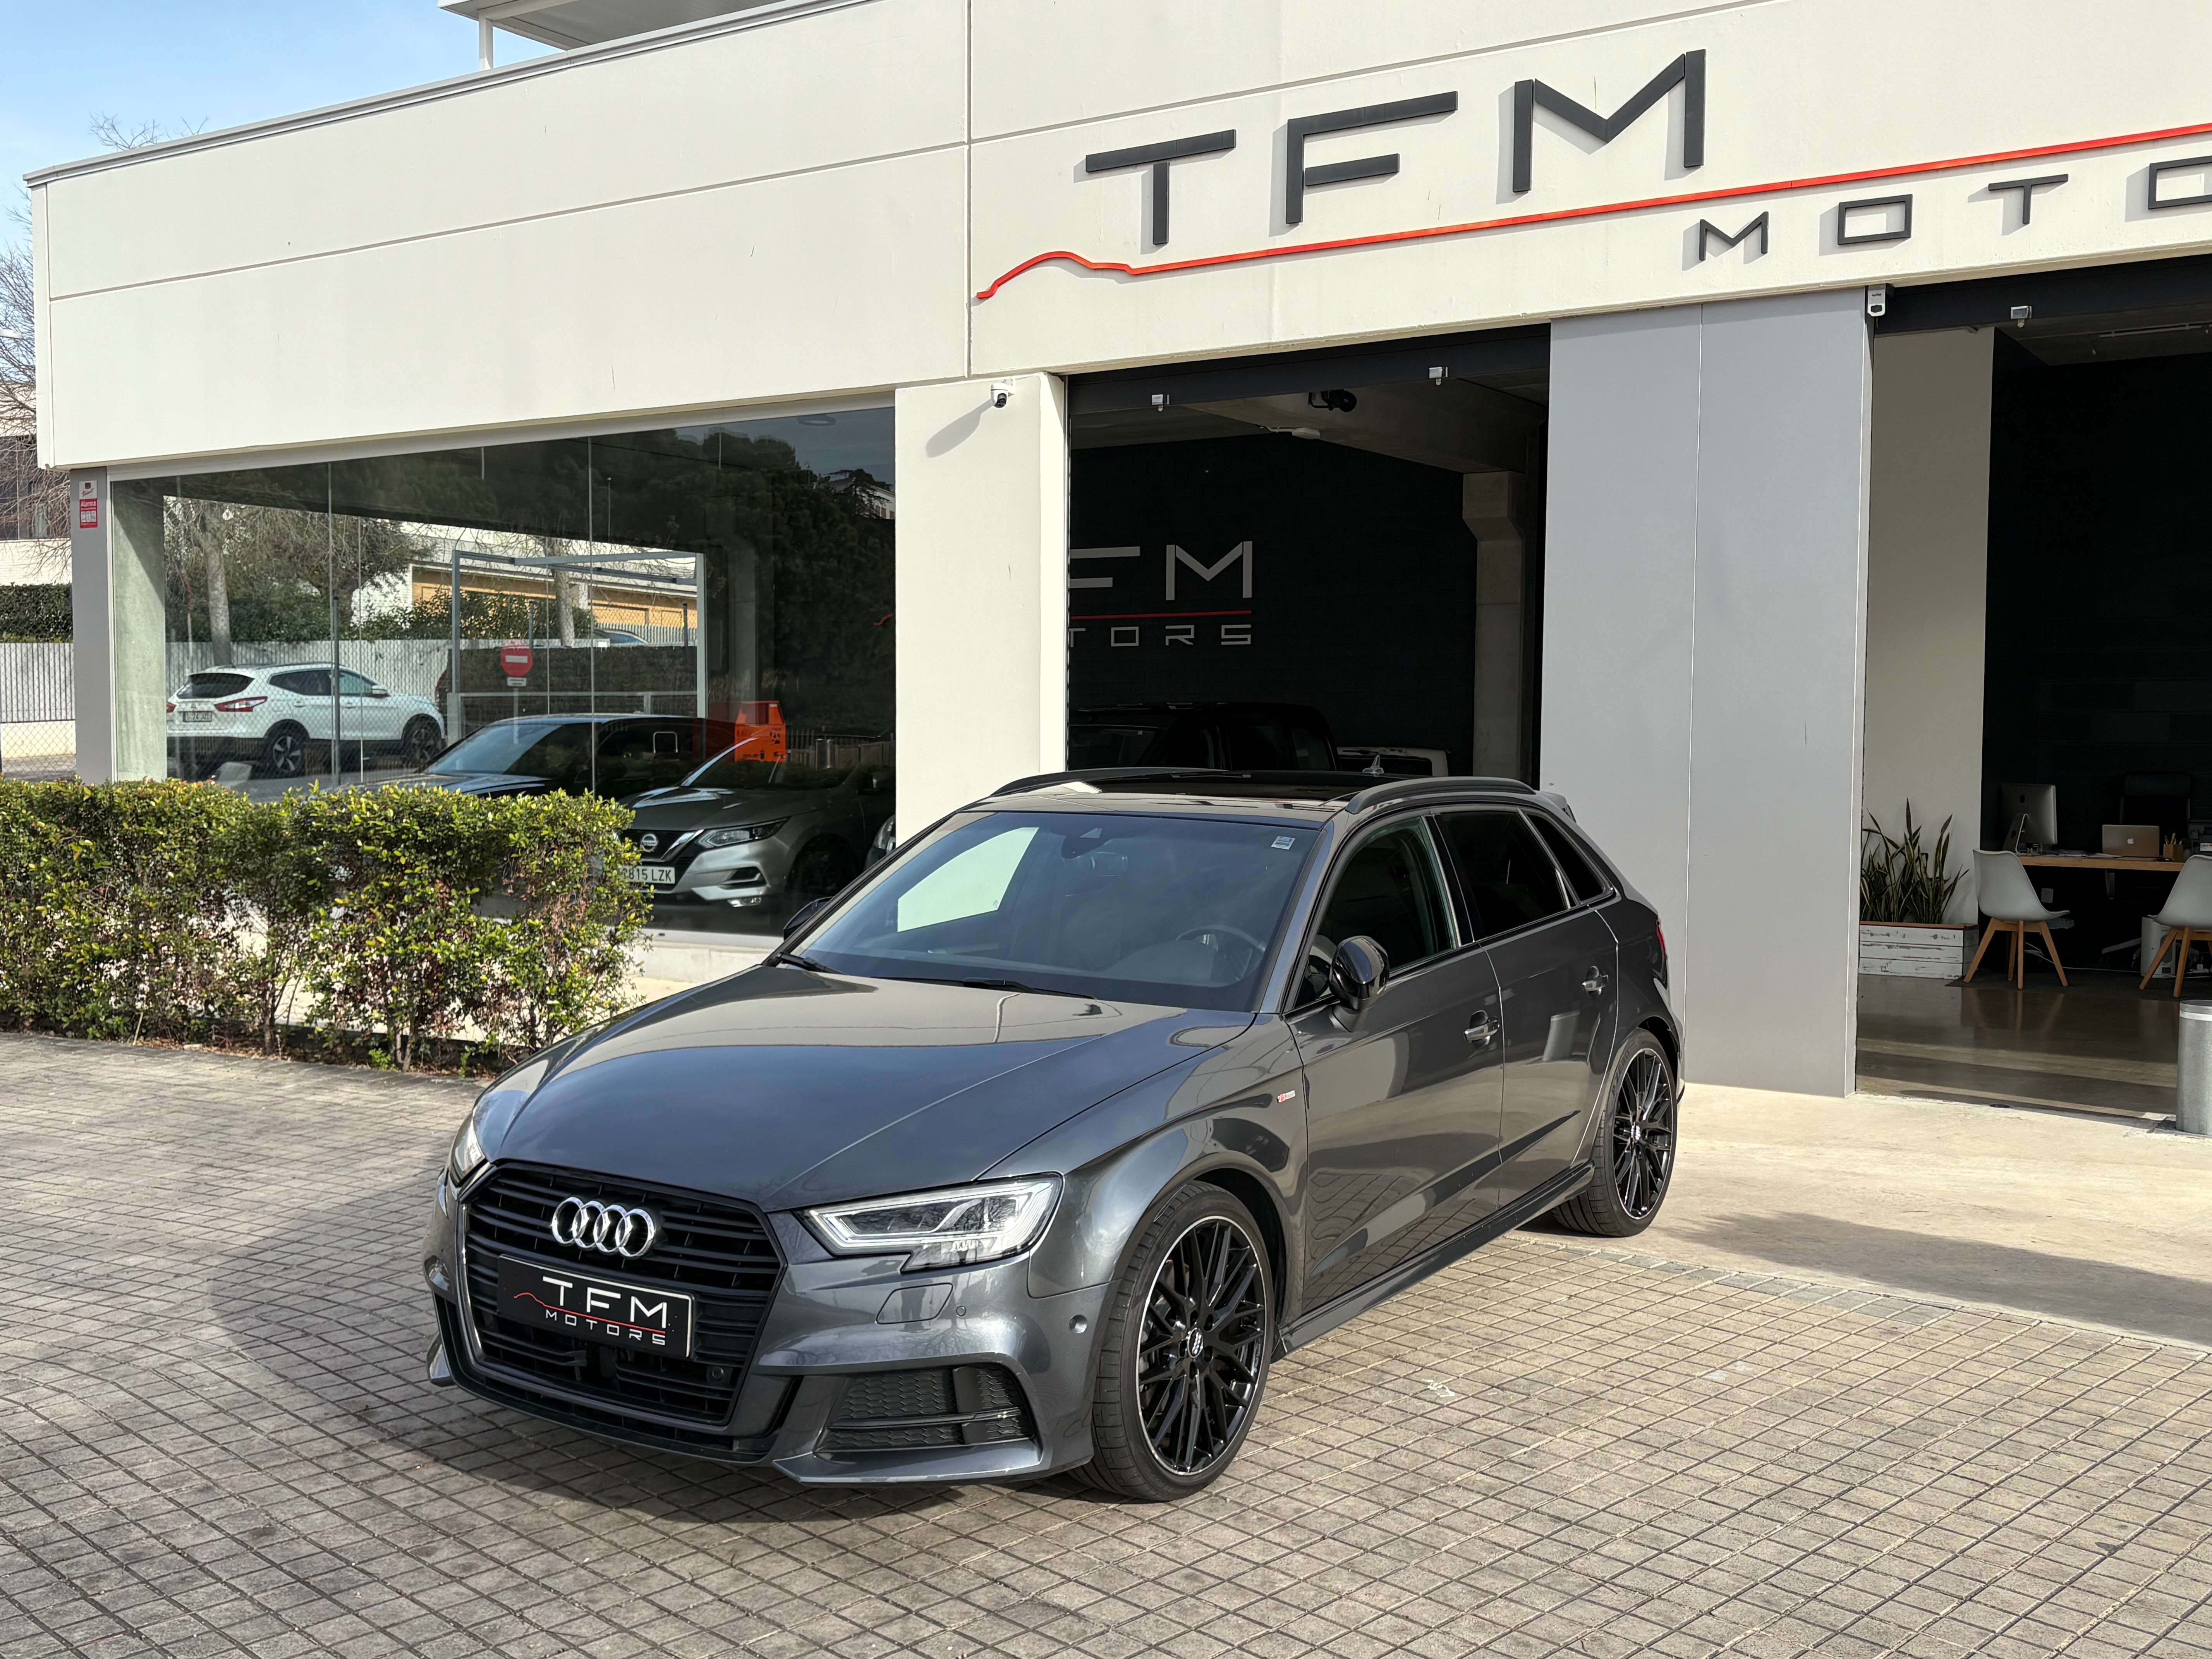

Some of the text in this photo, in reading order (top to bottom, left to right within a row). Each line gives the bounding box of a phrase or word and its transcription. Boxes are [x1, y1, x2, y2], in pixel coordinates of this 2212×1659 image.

[1085, 49, 1706, 246] TFM
[1699, 156, 2212, 261] MOTO
[651, 868, 671, 881] LZK
[543, 1276, 666, 1328] TFM
[546, 1309, 665, 1345] MOTORS
